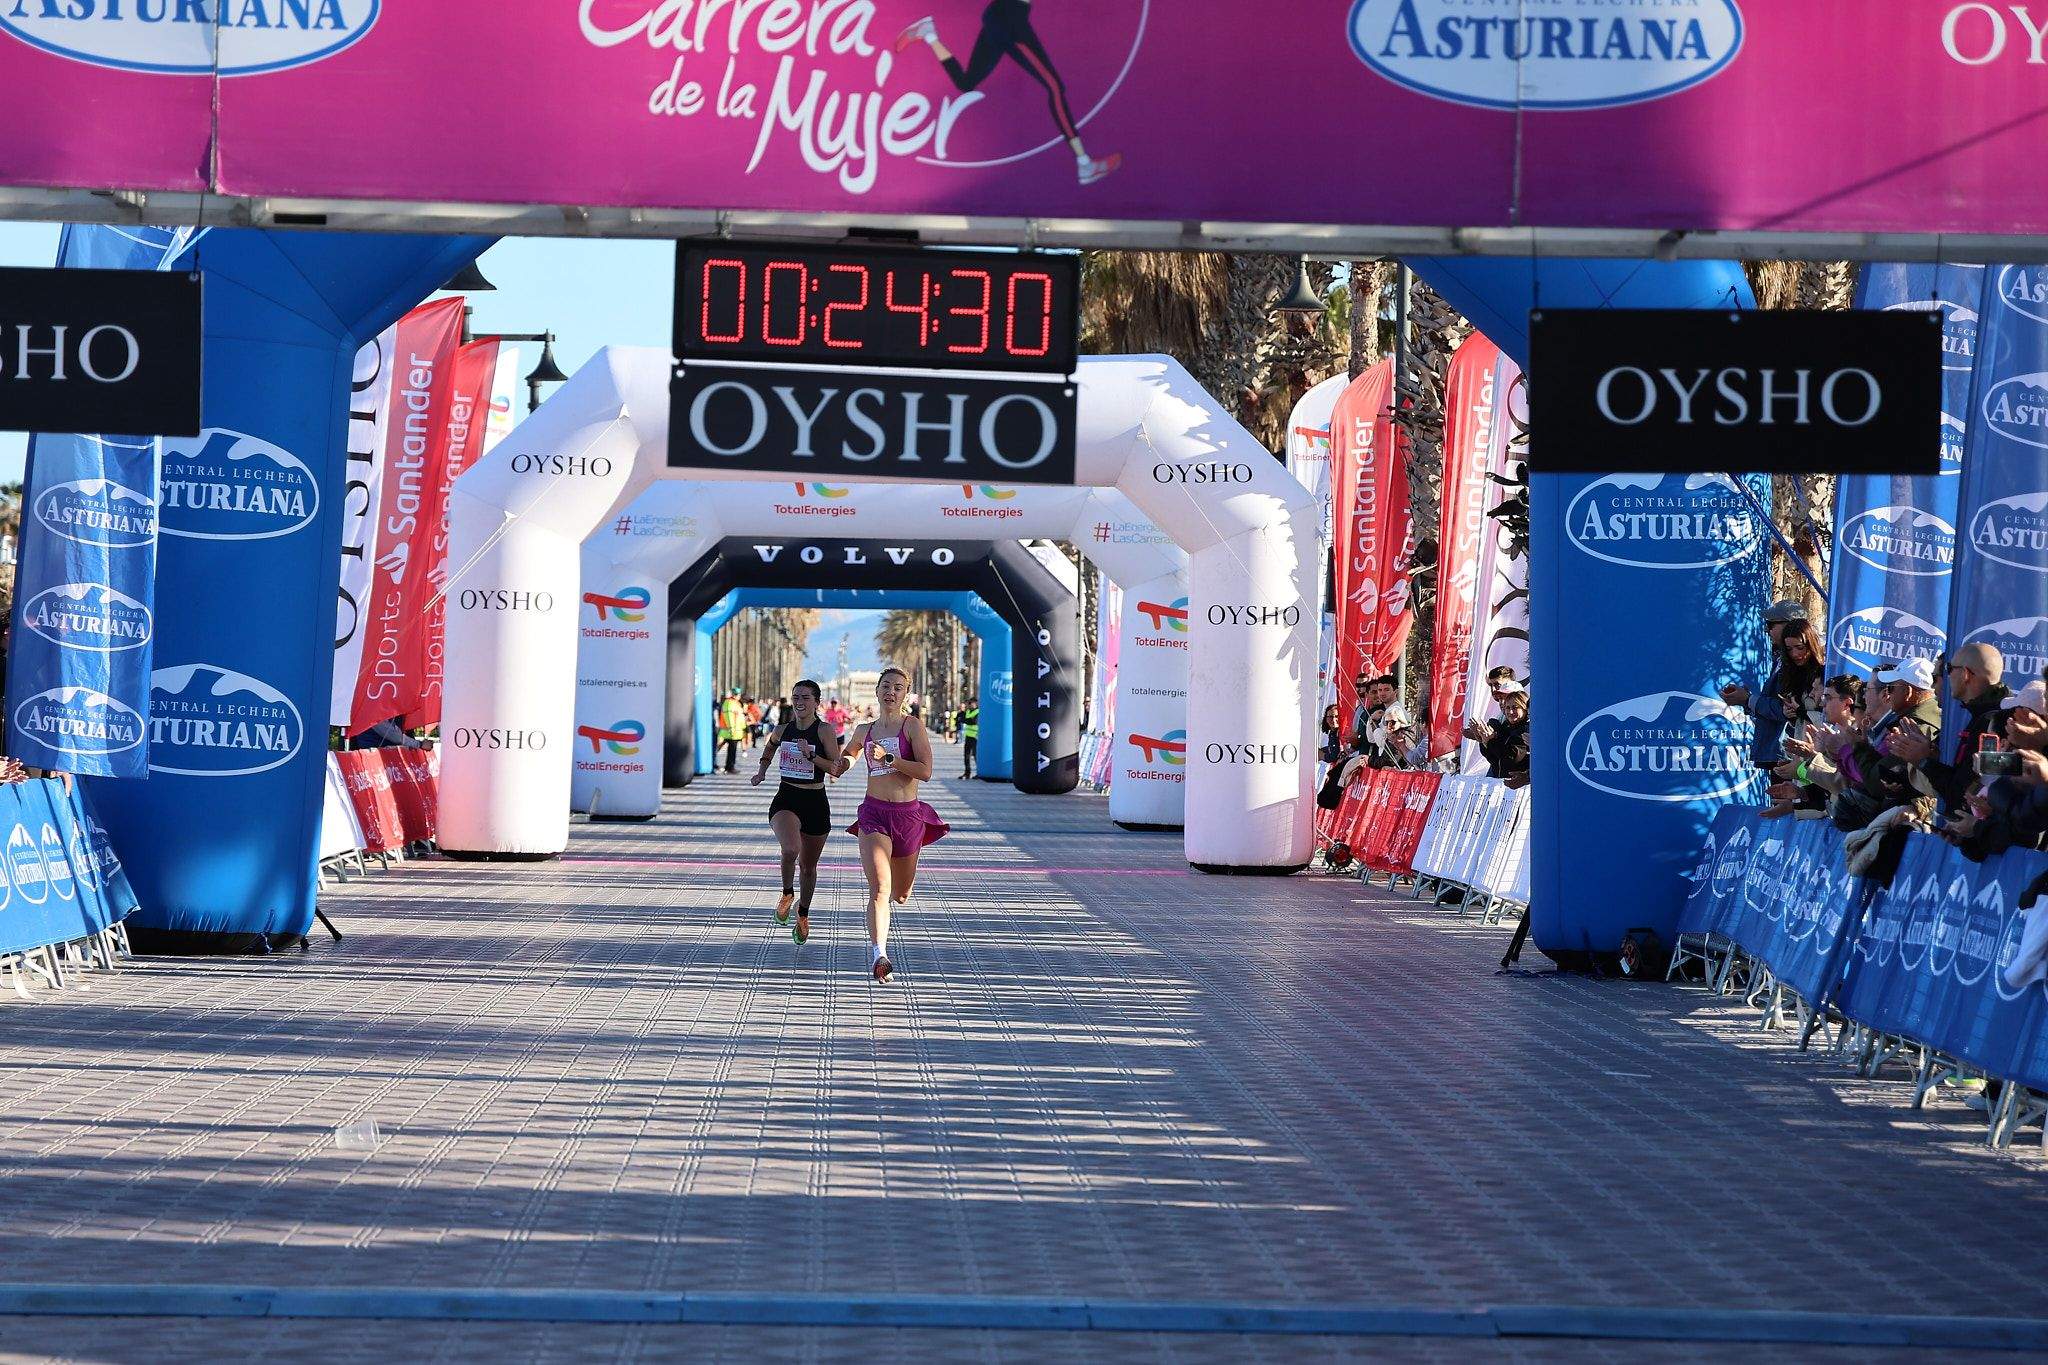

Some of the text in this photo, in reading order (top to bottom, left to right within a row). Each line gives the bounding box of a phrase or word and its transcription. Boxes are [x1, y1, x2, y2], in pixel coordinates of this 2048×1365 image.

[1379, 0, 1711, 60] ASTURIANA
[649, 50, 986, 194] de la Mujer
[701, 258, 1052, 356] 00:24:30
[1597, 366, 1882, 427] OYSHO
[689, 381, 1058, 470] OYSHO
[388, 352, 436, 535] Santander
[511, 454, 612, 477] OYSHO
[1294, 453, 1330, 461] TotalEner
[165, 464, 302, 484] ENTRAL LECHERA
[1153, 463, 1253, 483] OYSHO
[159, 479, 307, 518] TURIANA
[1351, 417, 1377, 572] Santander
[1611, 497, 1746, 508] CENTRAL LECHER
[44, 495, 156, 536] ASTURIANA
[774, 504, 856, 518] TotalEnergies
[941, 506, 1023, 519] TotalEnergies
[1871, 524, 1911, 537] CENTRAL
[753, 545, 955, 566] VOLVO
[52, 601, 98, 614] CENTRAL
[460, 589, 553, 612] OYSHO
[35, 601, 147, 640] ASTURIANA
[1207, 604, 1300, 627] OYSHO
[581, 628, 650, 640] TotalEnergies
[1859, 625, 1893, 638] CENTRAL
[366, 591, 405, 700] Sports
[421, 601, 446, 698] Sports
[579, 679, 648, 688] totalenergies.es
[44, 705, 85, 718] CENTRAL
[149, 700, 287, 719] ENTRAL LECHERA
[1037, 628, 1051, 773] VOLVO
[25, 705, 136, 743] ASTURIANA
[149, 715, 291, 752] TURIANA
[1611, 729, 1747, 739] CENTRAL LECHER
[454, 727, 547, 751] OYSHO
[1205, 743, 1298, 765] OYSHO
[576, 761, 644, 773] TotalEnergies
